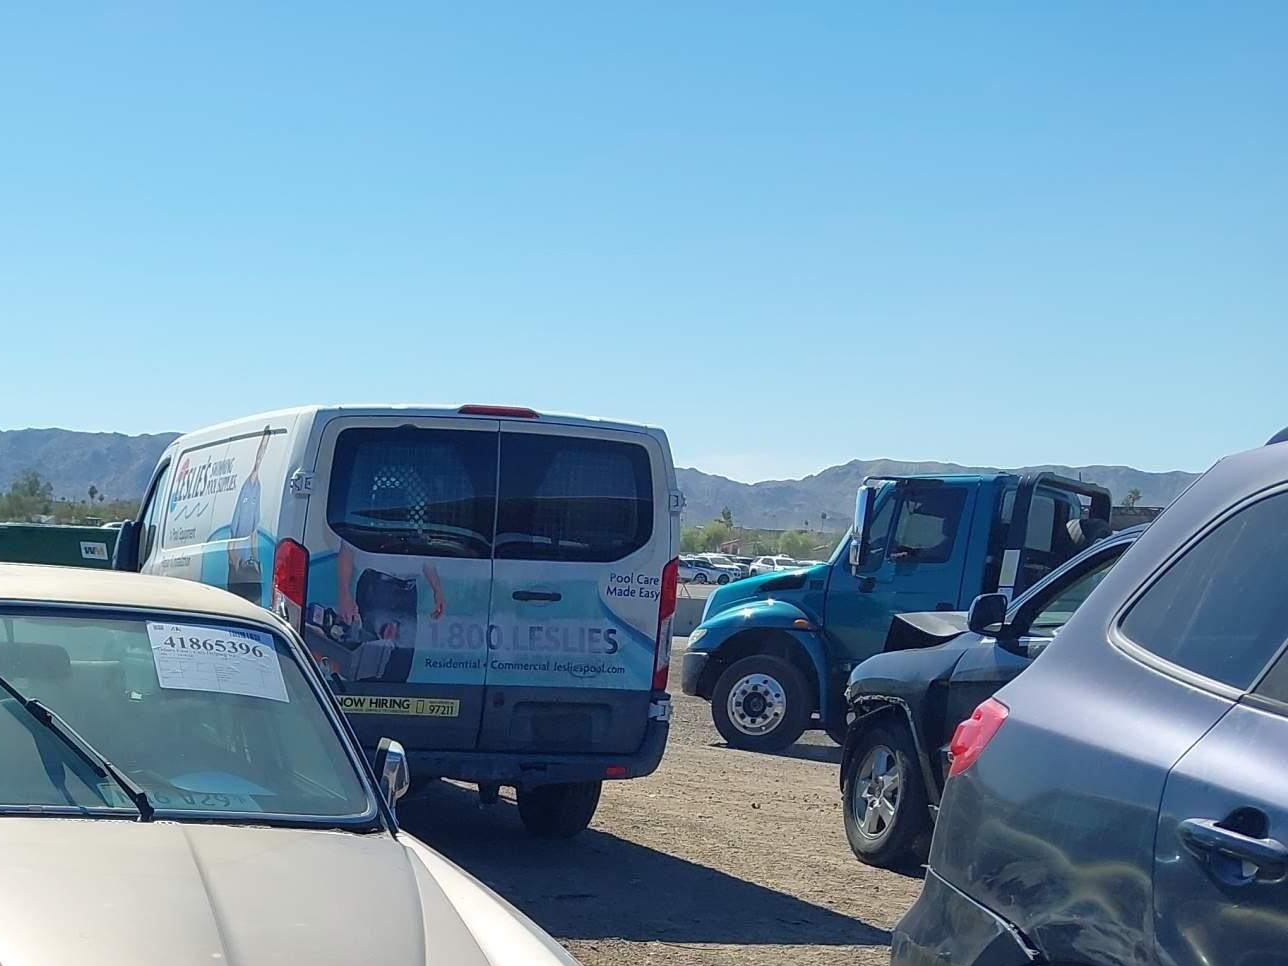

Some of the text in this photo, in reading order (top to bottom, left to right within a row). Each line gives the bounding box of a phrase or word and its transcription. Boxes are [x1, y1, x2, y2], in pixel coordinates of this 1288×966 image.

[610, 572, 660, 585] Pool Care
[606, 585, 660, 602] Made Easy
[164, 635, 264, 658] 41865396
[425, 658, 625, 675] Residential Commercial lesliespool.com
[369, 698, 411, 710] HIRING
[428, 704, 454, 715] 97211
